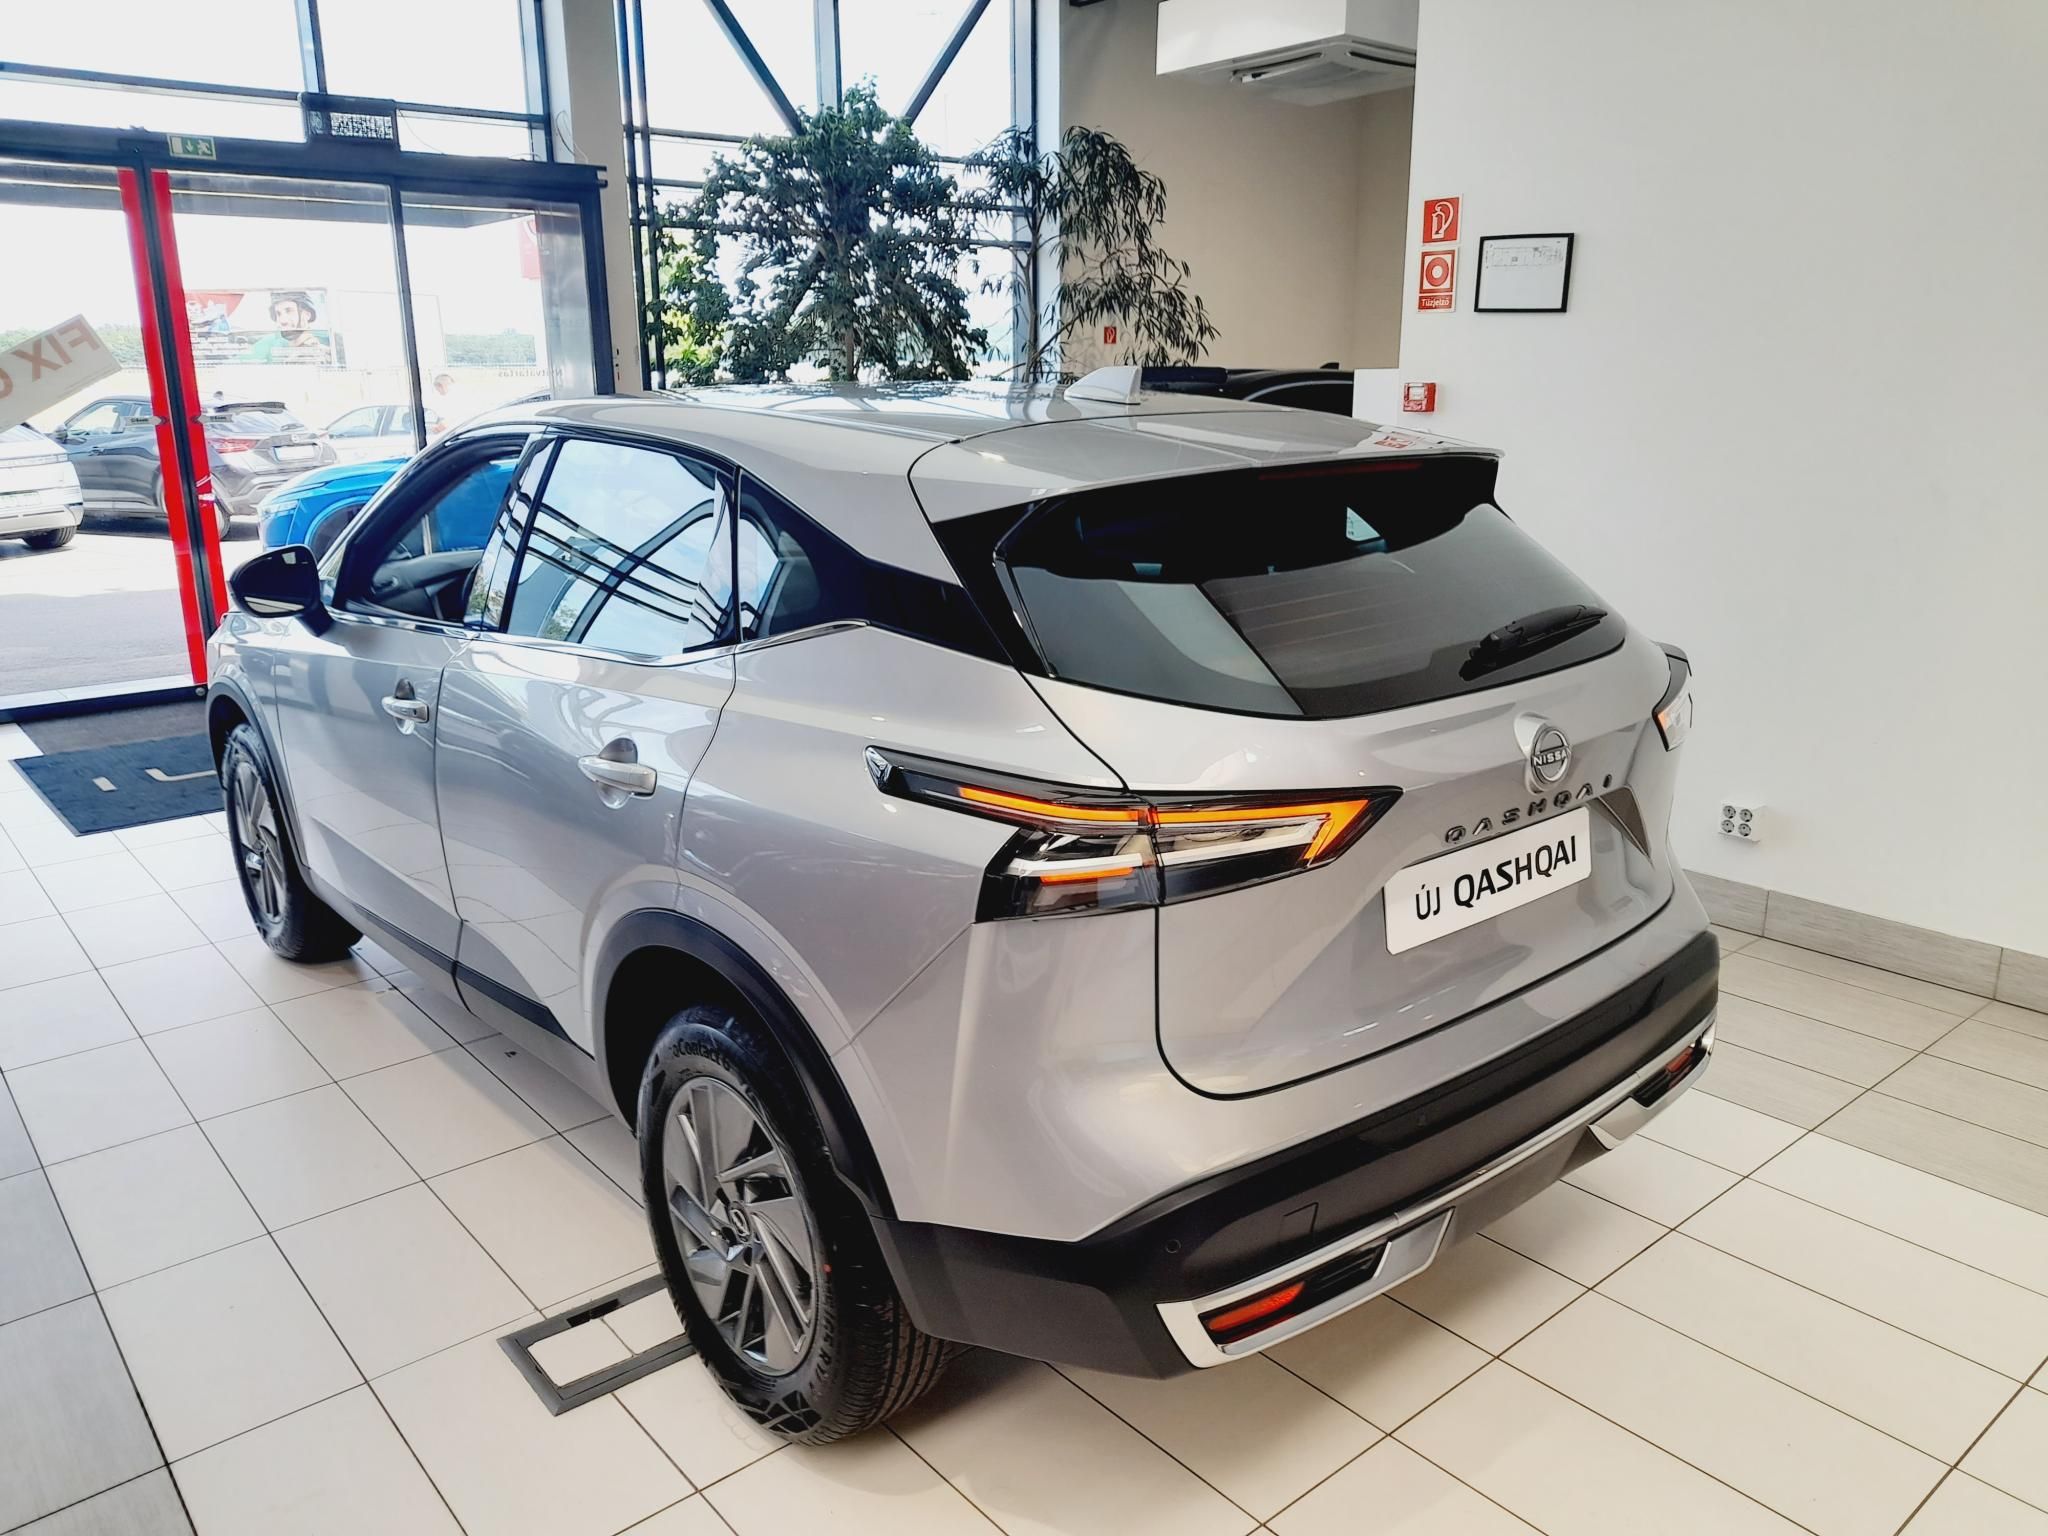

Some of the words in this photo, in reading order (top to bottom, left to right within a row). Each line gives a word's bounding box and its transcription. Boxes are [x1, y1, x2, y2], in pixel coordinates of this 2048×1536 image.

[1533, 748, 1568, 767] NISSA
[1445, 773, 1612, 844] QASHQAI
[1415, 884, 1441, 920] ÚJ
[1453, 835, 1577, 908] QASHQAI
